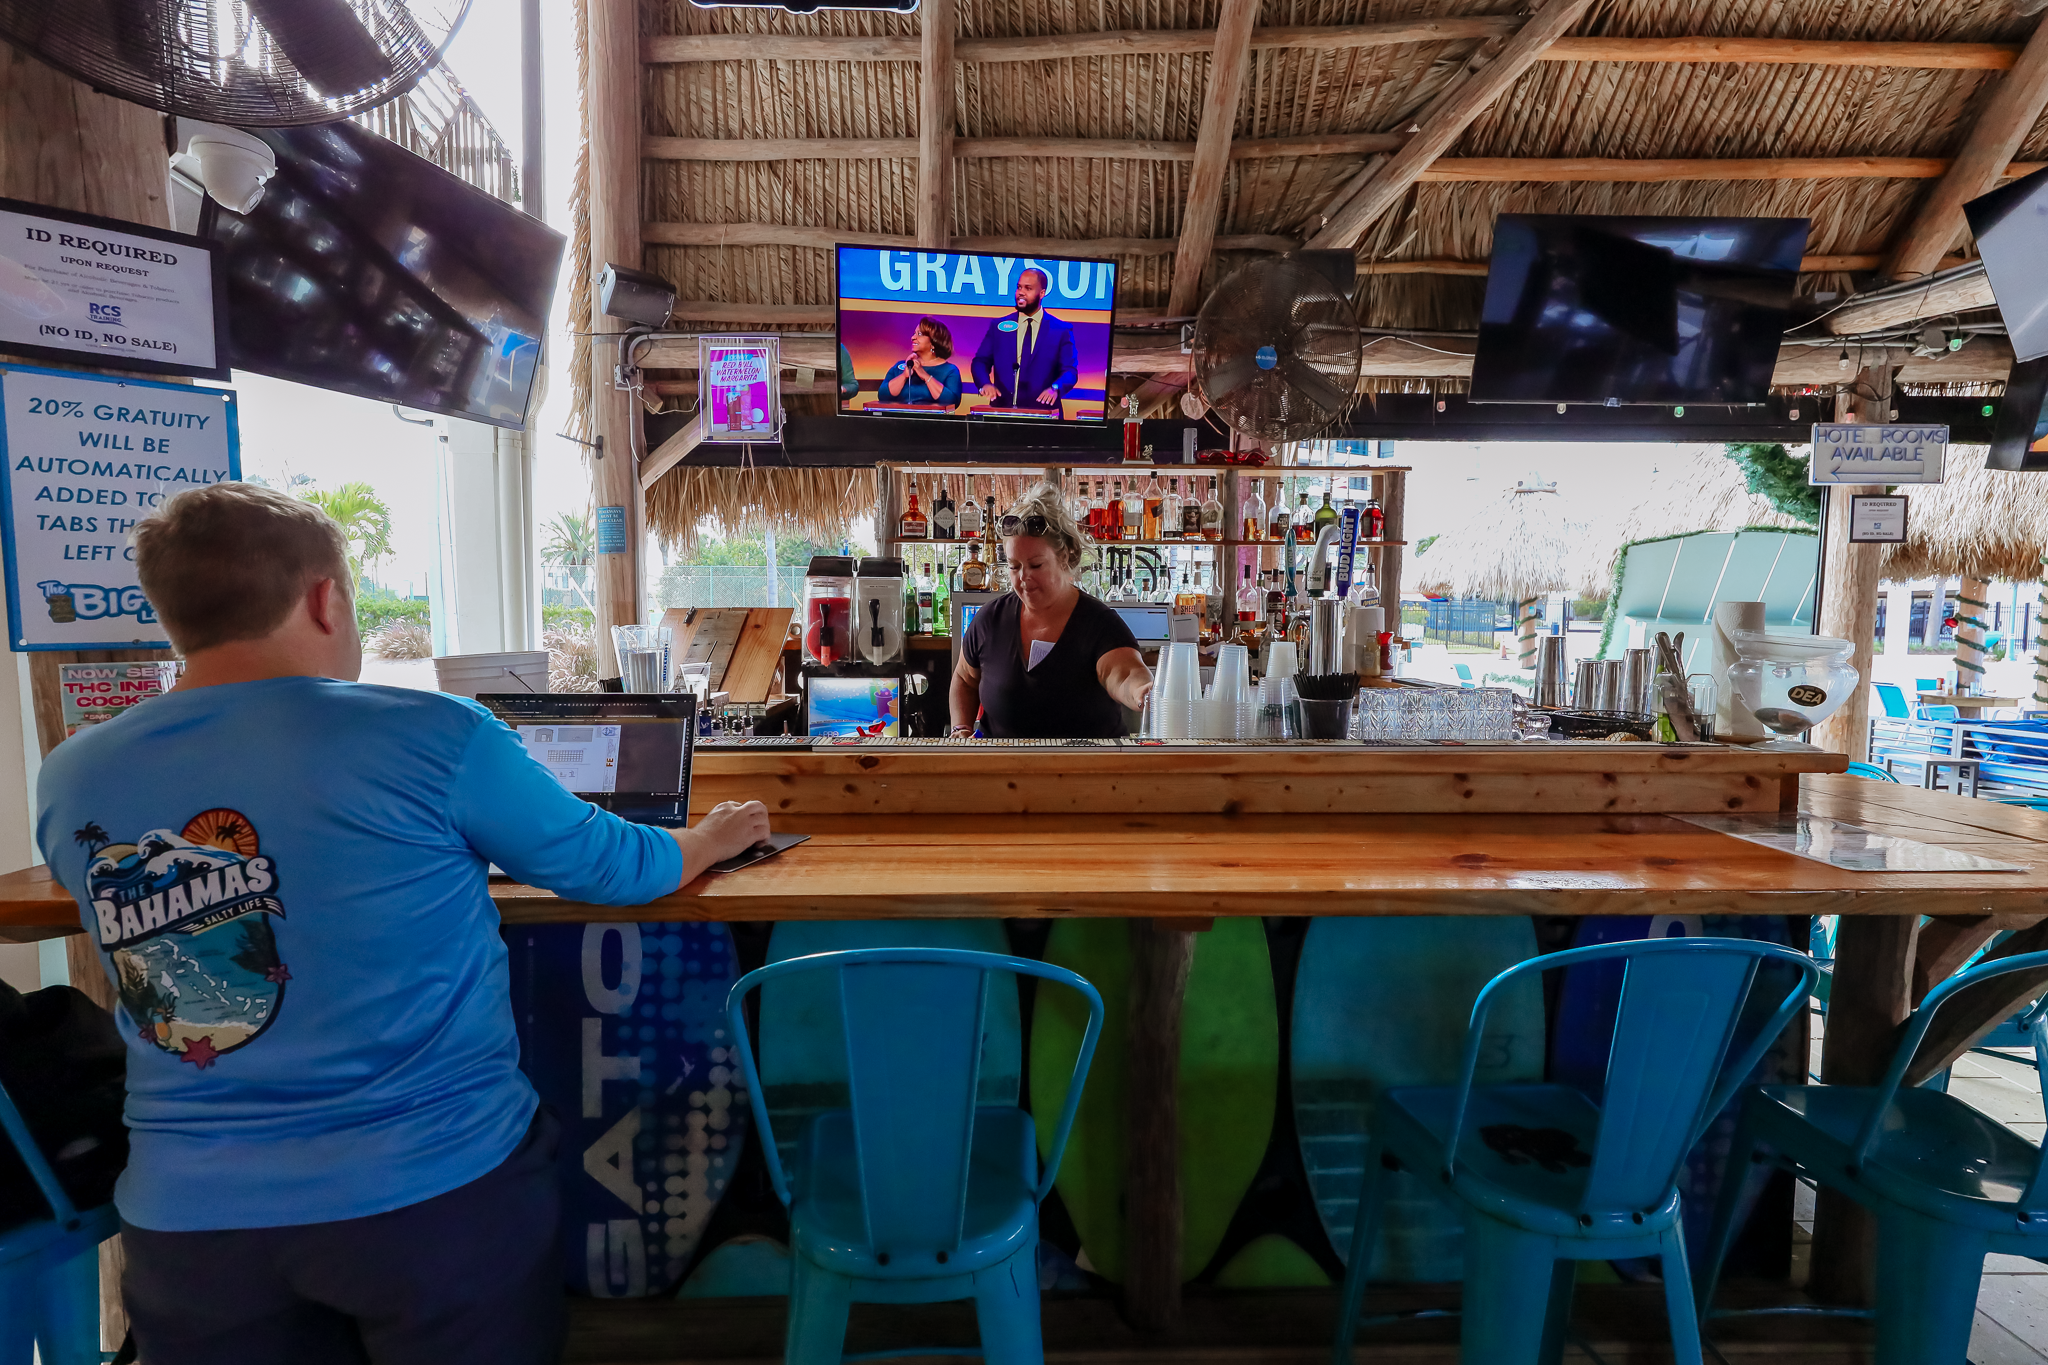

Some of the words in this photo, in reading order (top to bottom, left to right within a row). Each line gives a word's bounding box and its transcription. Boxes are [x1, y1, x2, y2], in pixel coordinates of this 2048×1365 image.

[26, 227, 52, 243] ID
[58, 233, 178, 266] REQUIRED
[60, 255, 92, 268] UPON
[96, 262, 150, 277] REQUEST
[89, 302, 122, 318] RCS
[90, 314, 122, 323] TRAINING
[39, 324, 70, 337] (NO
[75, 329, 98, 343] ID,
[102, 333, 127, 345] NO
[131, 337, 178, 354] SALE)
[716, 367, 761, 376] WATERMELON
[720, 374, 758, 382] MARGARITA
[28, 397, 84, 419] 20%
[93, 404, 210, 430] GRATUITY
[78, 431, 134, 451] WILL
[142, 437, 170, 454] BE
[1880, 429, 1945, 444] ROOMS
[1831, 446, 1924, 461] AVAILABLE
[15, 455, 228, 484] AUTOMATICALLY
[34, 486, 128, 506] ADDED
[36, 514, 98, 533] TABS
[1341, 515, 1355, 553] LIGHT
[63, 544, 116, 561] LEFT
[1287, 545, 1295, 568] KONA
[1338, 554, 1351, 582] BUD
[38, 582, 68, 597] The
[70, 587, 146, 617] BIG
[67, 668, 118, 679] NOW
[63, 681, 112, 694] THC
[1791, 687, 1823, 704] DEA
[92, 857, 272, 945] BAHAMAS
[119, 883, 146, 903] THE
[204, 906, 234, 926] SALTY
[238, 897, 262, 913] LIFE
